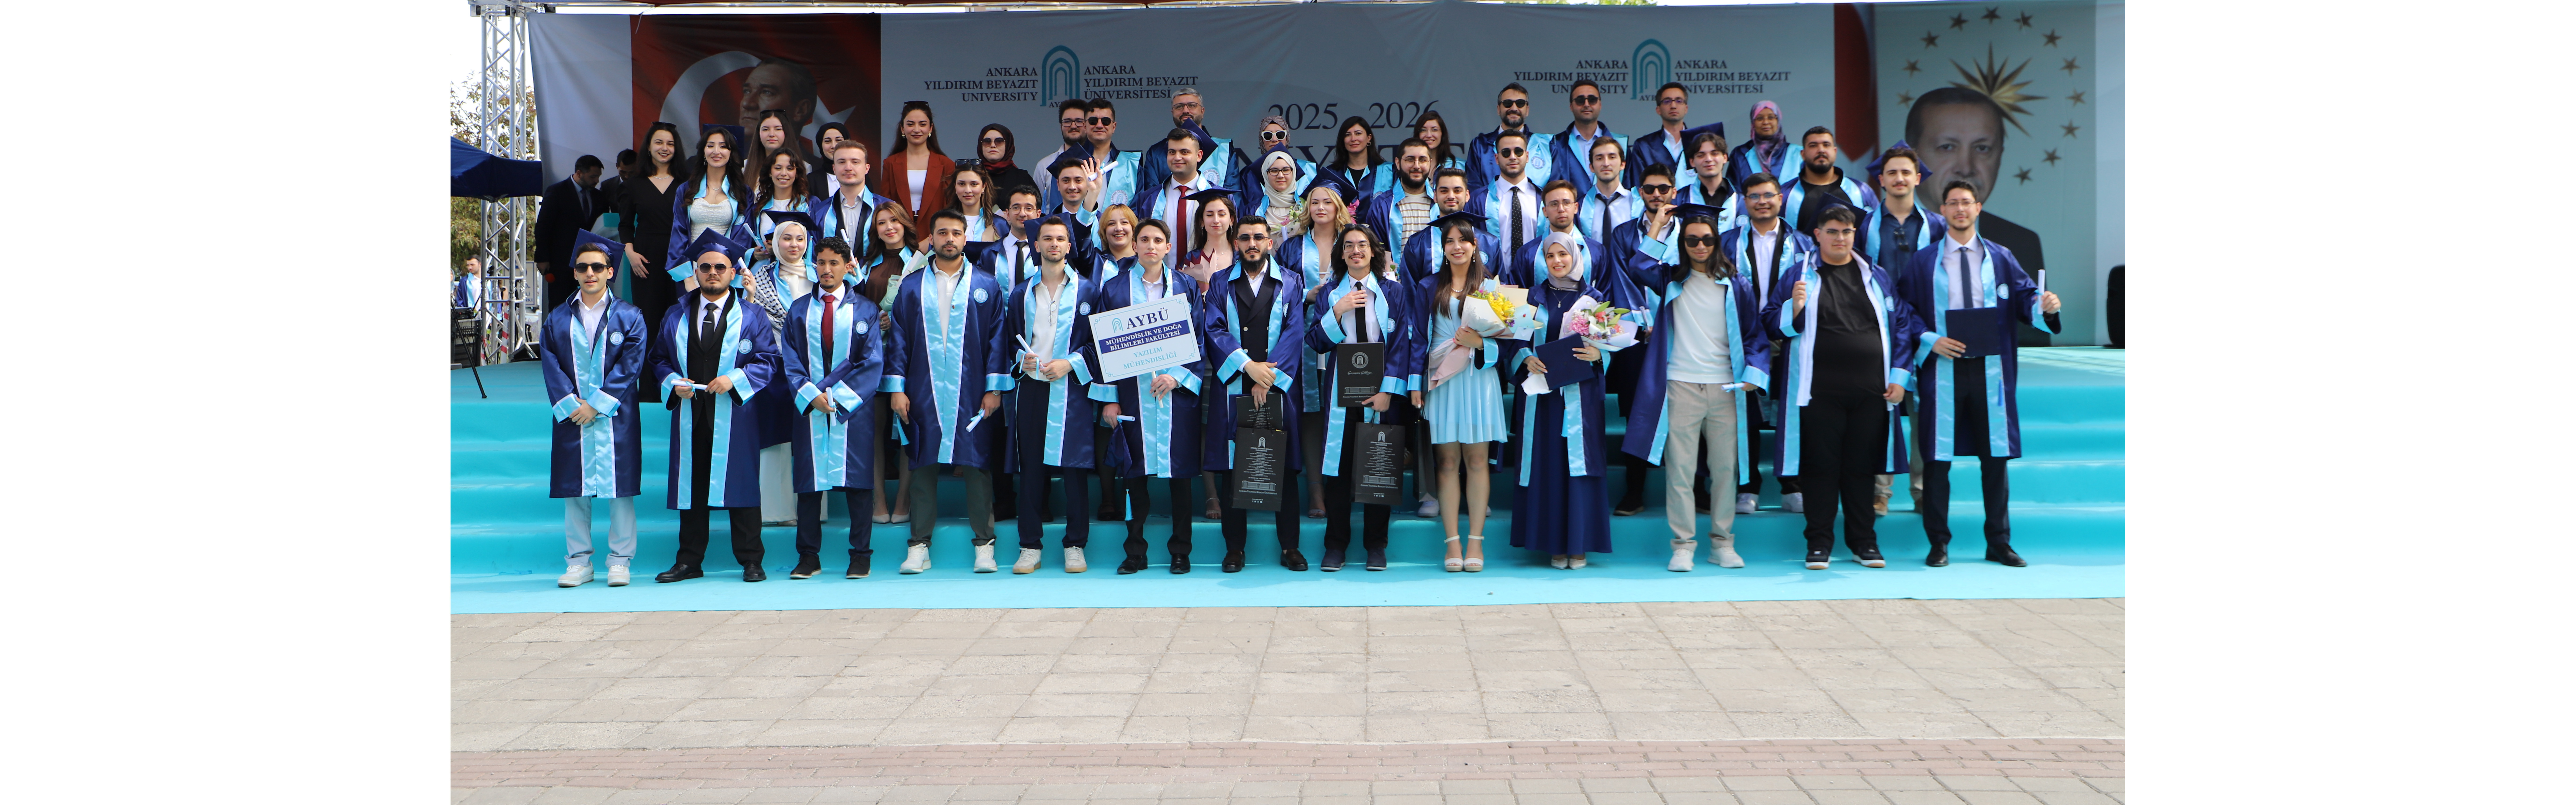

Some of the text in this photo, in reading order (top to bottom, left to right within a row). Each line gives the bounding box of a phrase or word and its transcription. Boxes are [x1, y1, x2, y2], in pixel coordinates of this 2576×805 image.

[1576, 60, 1628, 69] ANKARA
[1675, 60, 1727, 69] ANKARA
[986, 67, 1038, 76] ANKARA
[1084, 65, 1136, 75] ANKARA
[1514, 72, 1628, 81] YILDIRIM BEYAZIT
[1675, 71, 1791, 81] YILDIRIM BEYAZIT
[924, 80, 1038, 90] YILDIRIM BEYAZIT
[1084, 76, 1198, 87] YILDIRIM BEYAZIT
[1552, 85, 1628, 94] UNSITY
[1684, 82, 1763, 94] NİVERSİTESİ
[962, 92, 1038, 101] UNIVERSITY
[1084, 87, 1171, 100] ÜNİVERSİTESİ
[1127, 307, 1169, 330] AYBÜ
[1106, 330, 1152, 346] MÜHENDİSLİK
[1163, 323, 1182, 332] DOĞA
[1110, 330, 1180, 351] BİLİMLERİ FAKÜLTESİ
[1133, 346, 1162, 358] YAZILIM
[1124, 351, 1177, 369] MÜHENDİSLİĞİ
